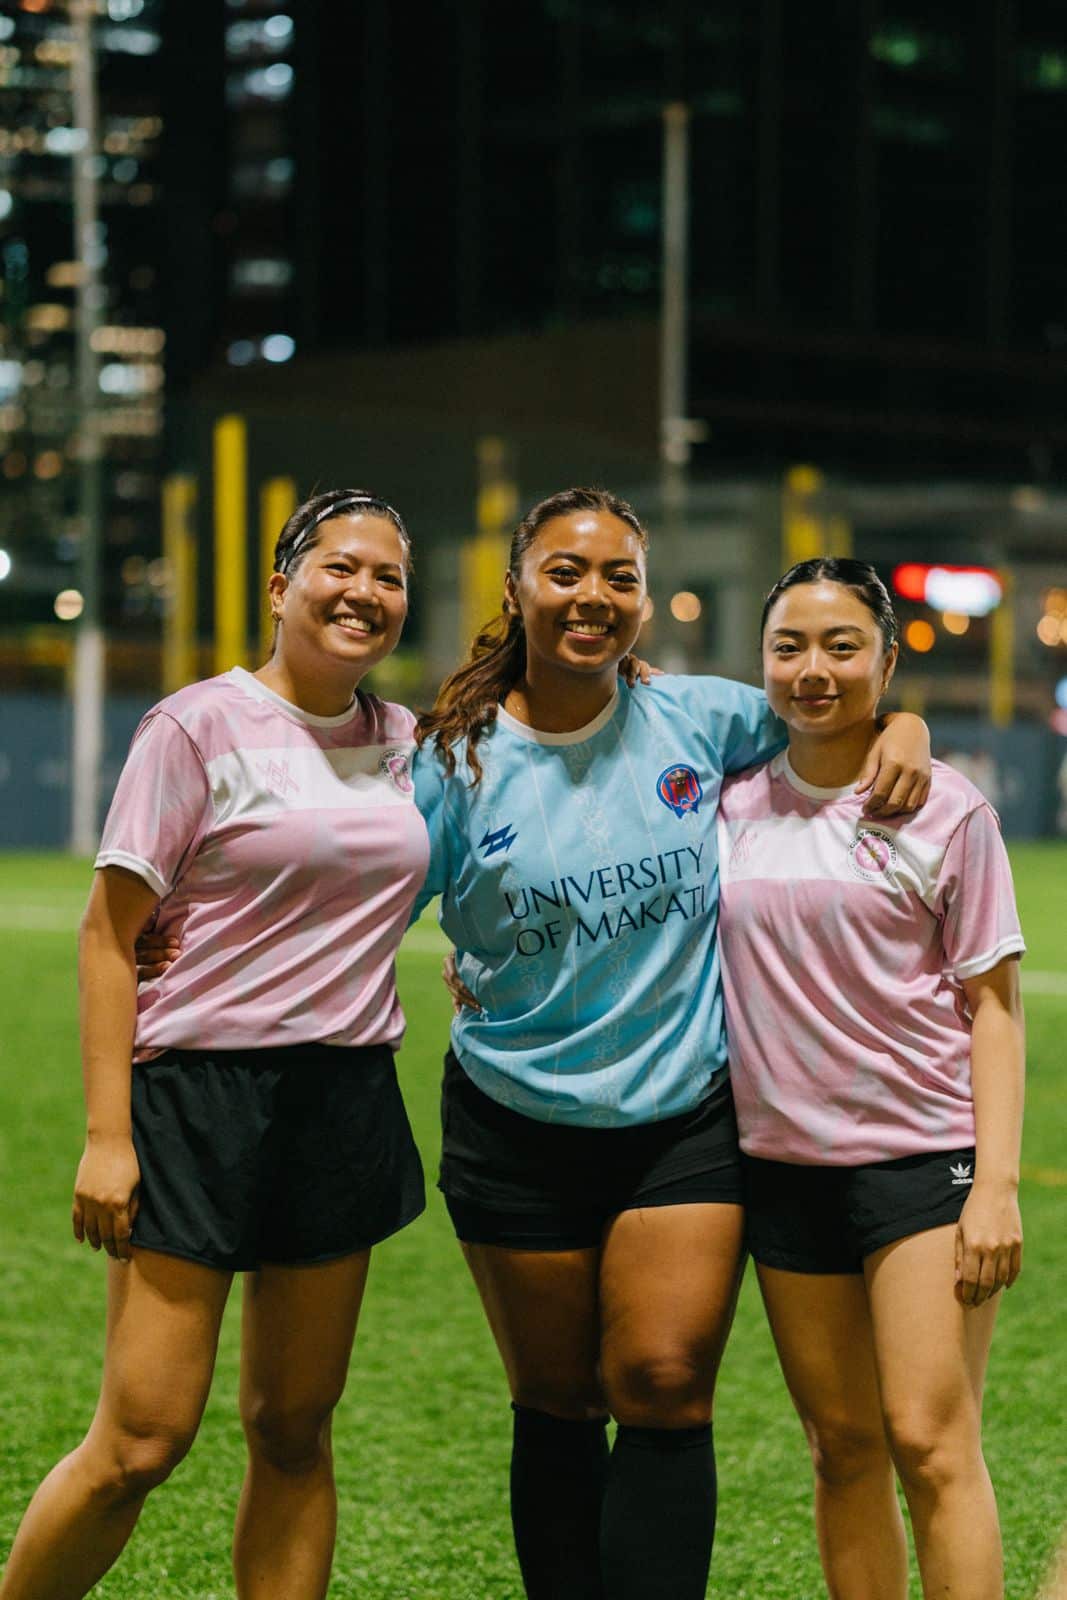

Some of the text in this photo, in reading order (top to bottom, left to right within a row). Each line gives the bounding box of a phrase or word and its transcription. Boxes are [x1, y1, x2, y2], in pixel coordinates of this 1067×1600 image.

[504, 843, 704, 921] UNIVERSITY
[516, 885, 706, 957] OF MAKATI
